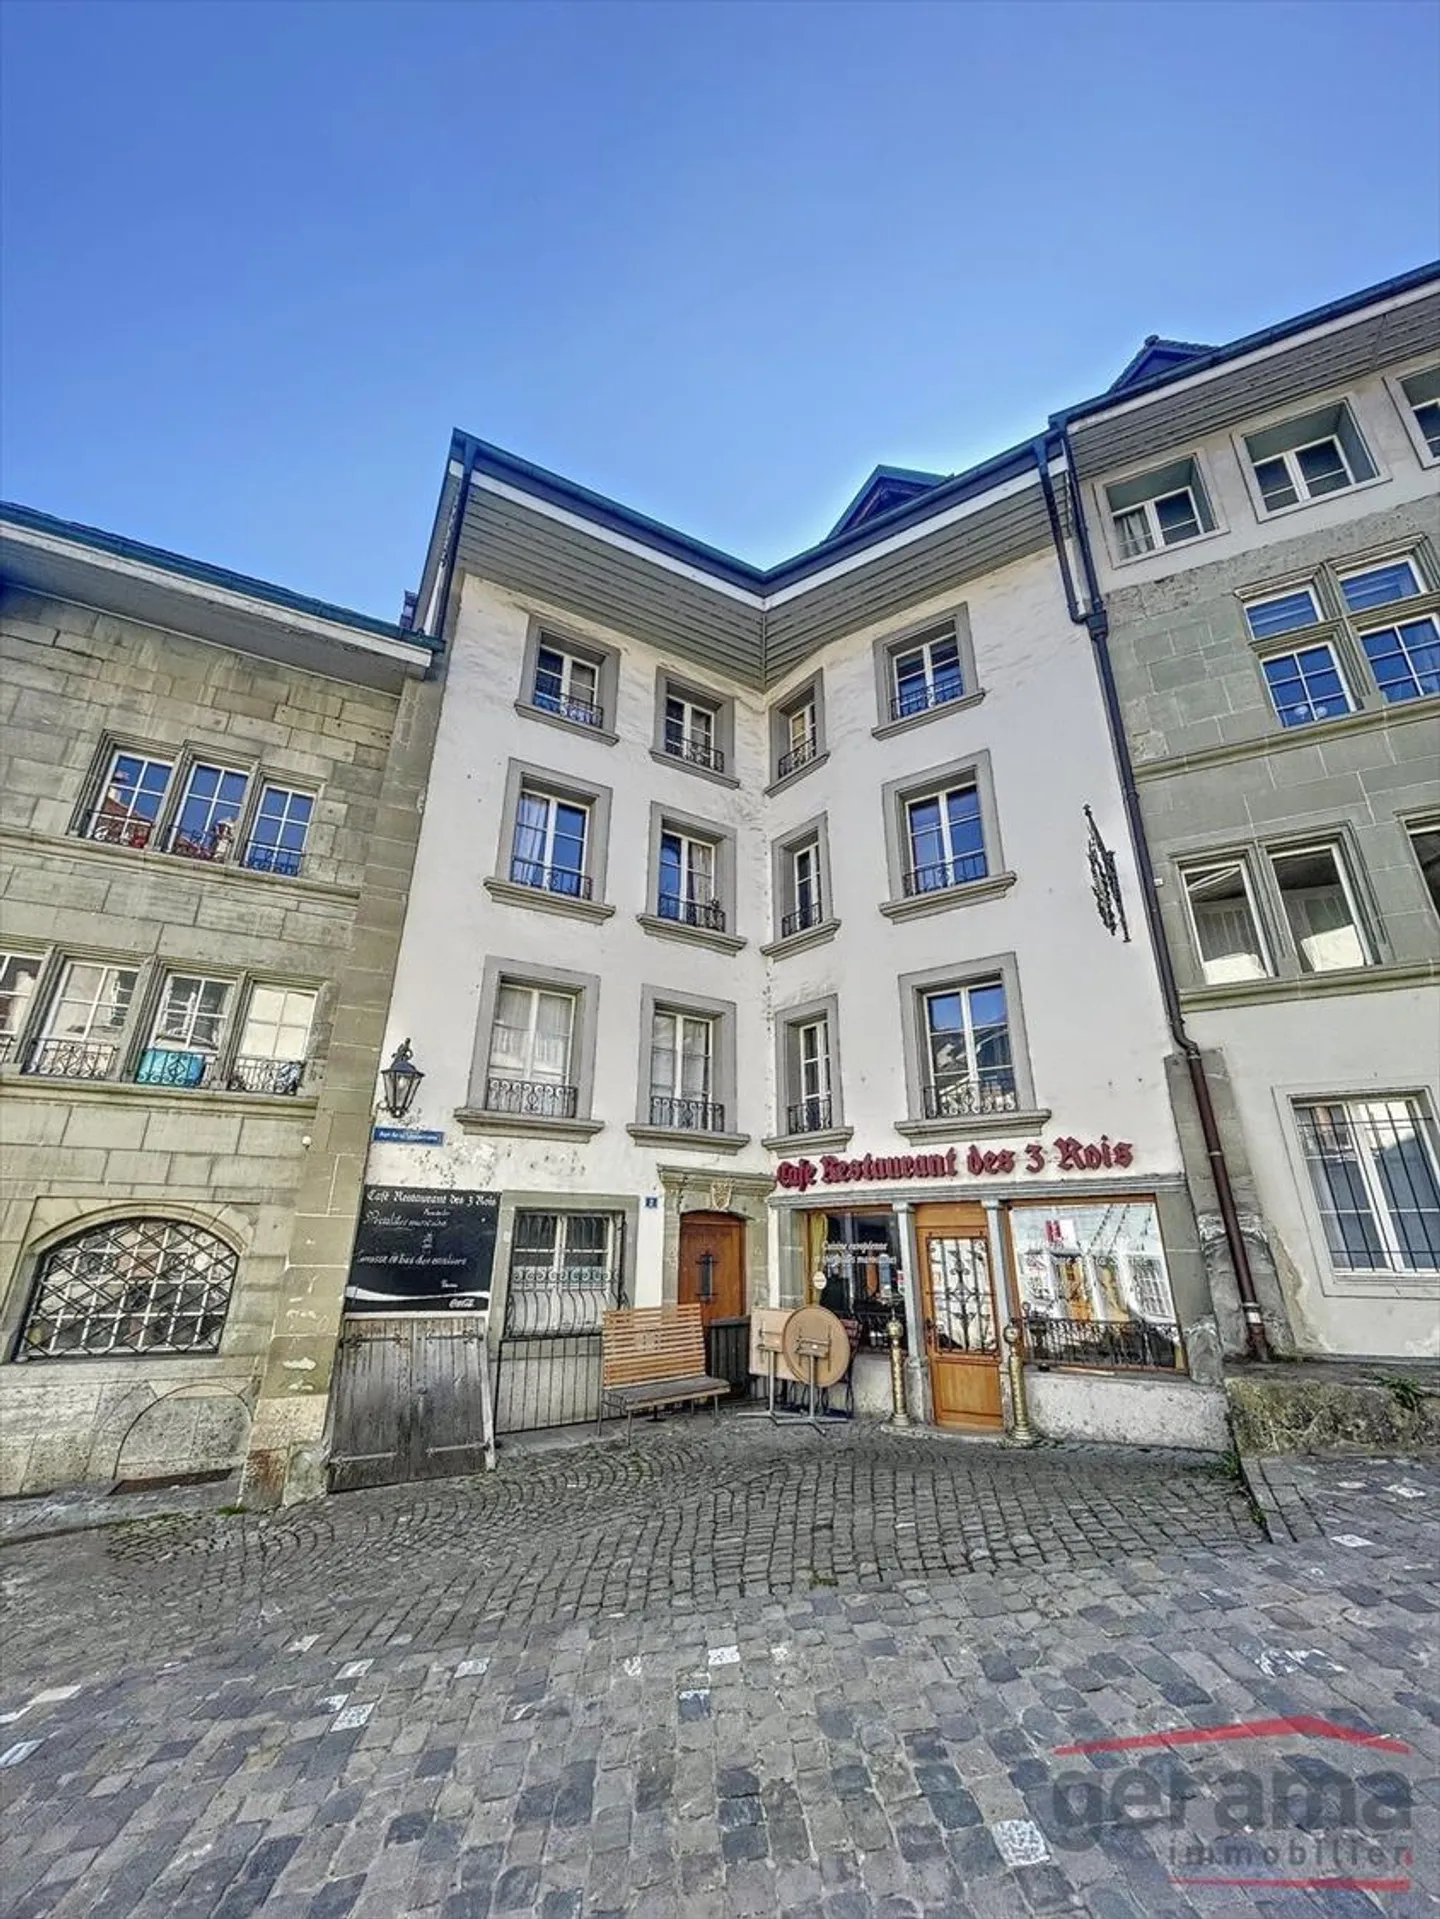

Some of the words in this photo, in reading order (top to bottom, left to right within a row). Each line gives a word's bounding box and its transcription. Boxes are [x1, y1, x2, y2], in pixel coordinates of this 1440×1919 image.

[820, 1147, 958, 1183] Restaurant
[967, 1144, 1016, 1175] des
[1025, 1142, 1046, 1174] 3
[1054, 1135, 1134, 1170] Rois
[394, 1190, 447, 1205] Restaurant
[449, 1194, 464, 1206] des
[466, 1196, 473, 1207] 3
[475, 1195, 497, 1207] Rois
